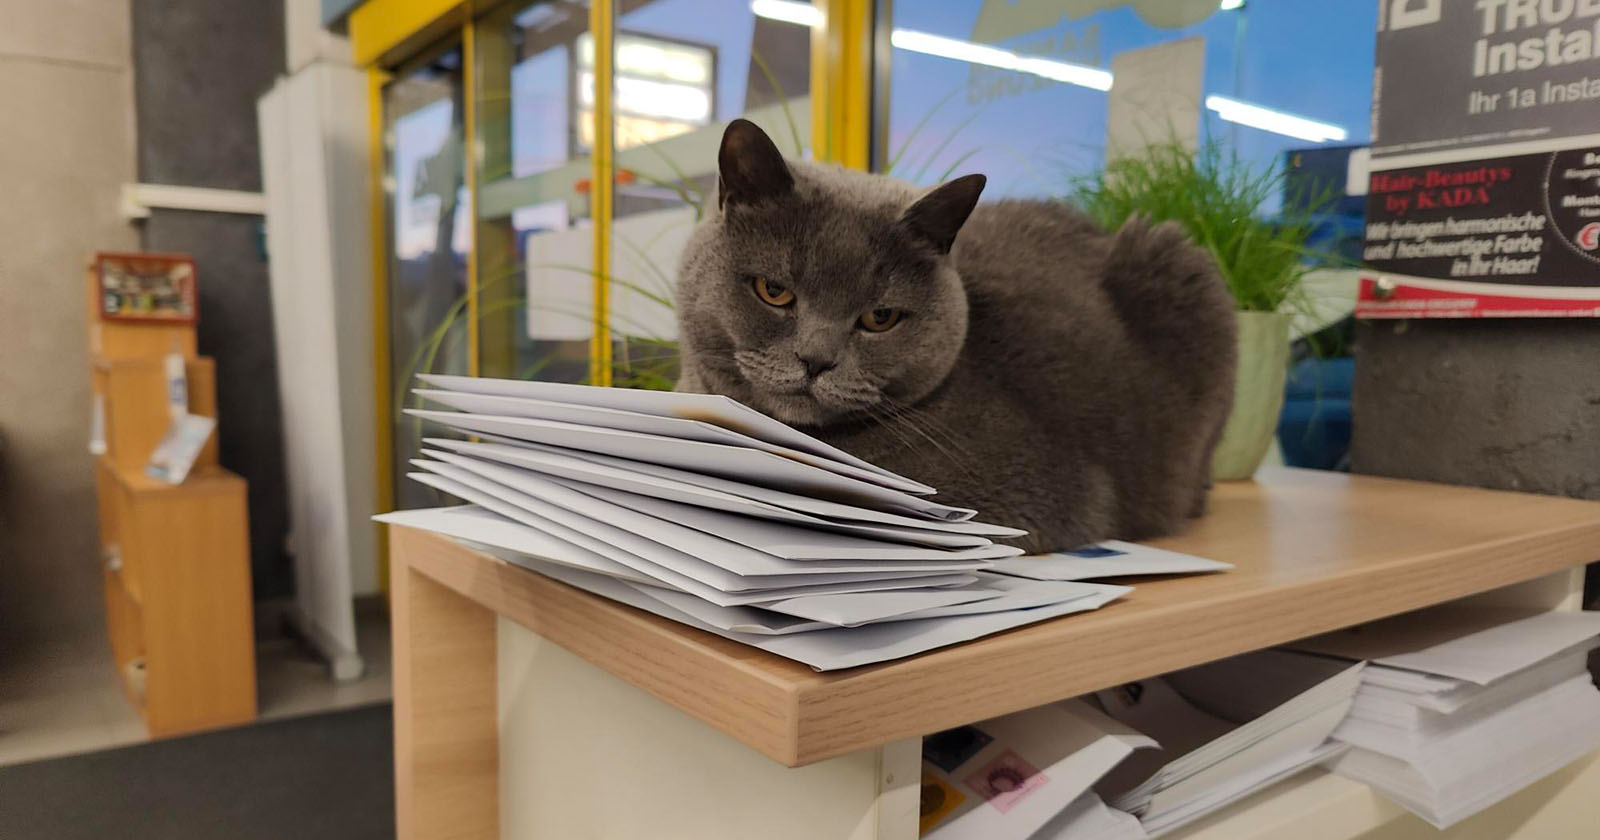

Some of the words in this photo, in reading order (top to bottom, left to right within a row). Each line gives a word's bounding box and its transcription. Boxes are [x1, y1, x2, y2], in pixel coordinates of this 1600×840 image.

[1468, 90, 1500, 115] Ihr
[1507, 87, 1536, 109] 1a
[1386, 195, 1408, 216] by
[1417, 187, 1490, 210] KADA
[1445, 210, 1546, 236] harmonische
[1363, 240, 1396, 260] und
[1494, 231, 1543, 254] Farbe
[1451, 259, 1469, 277] in
